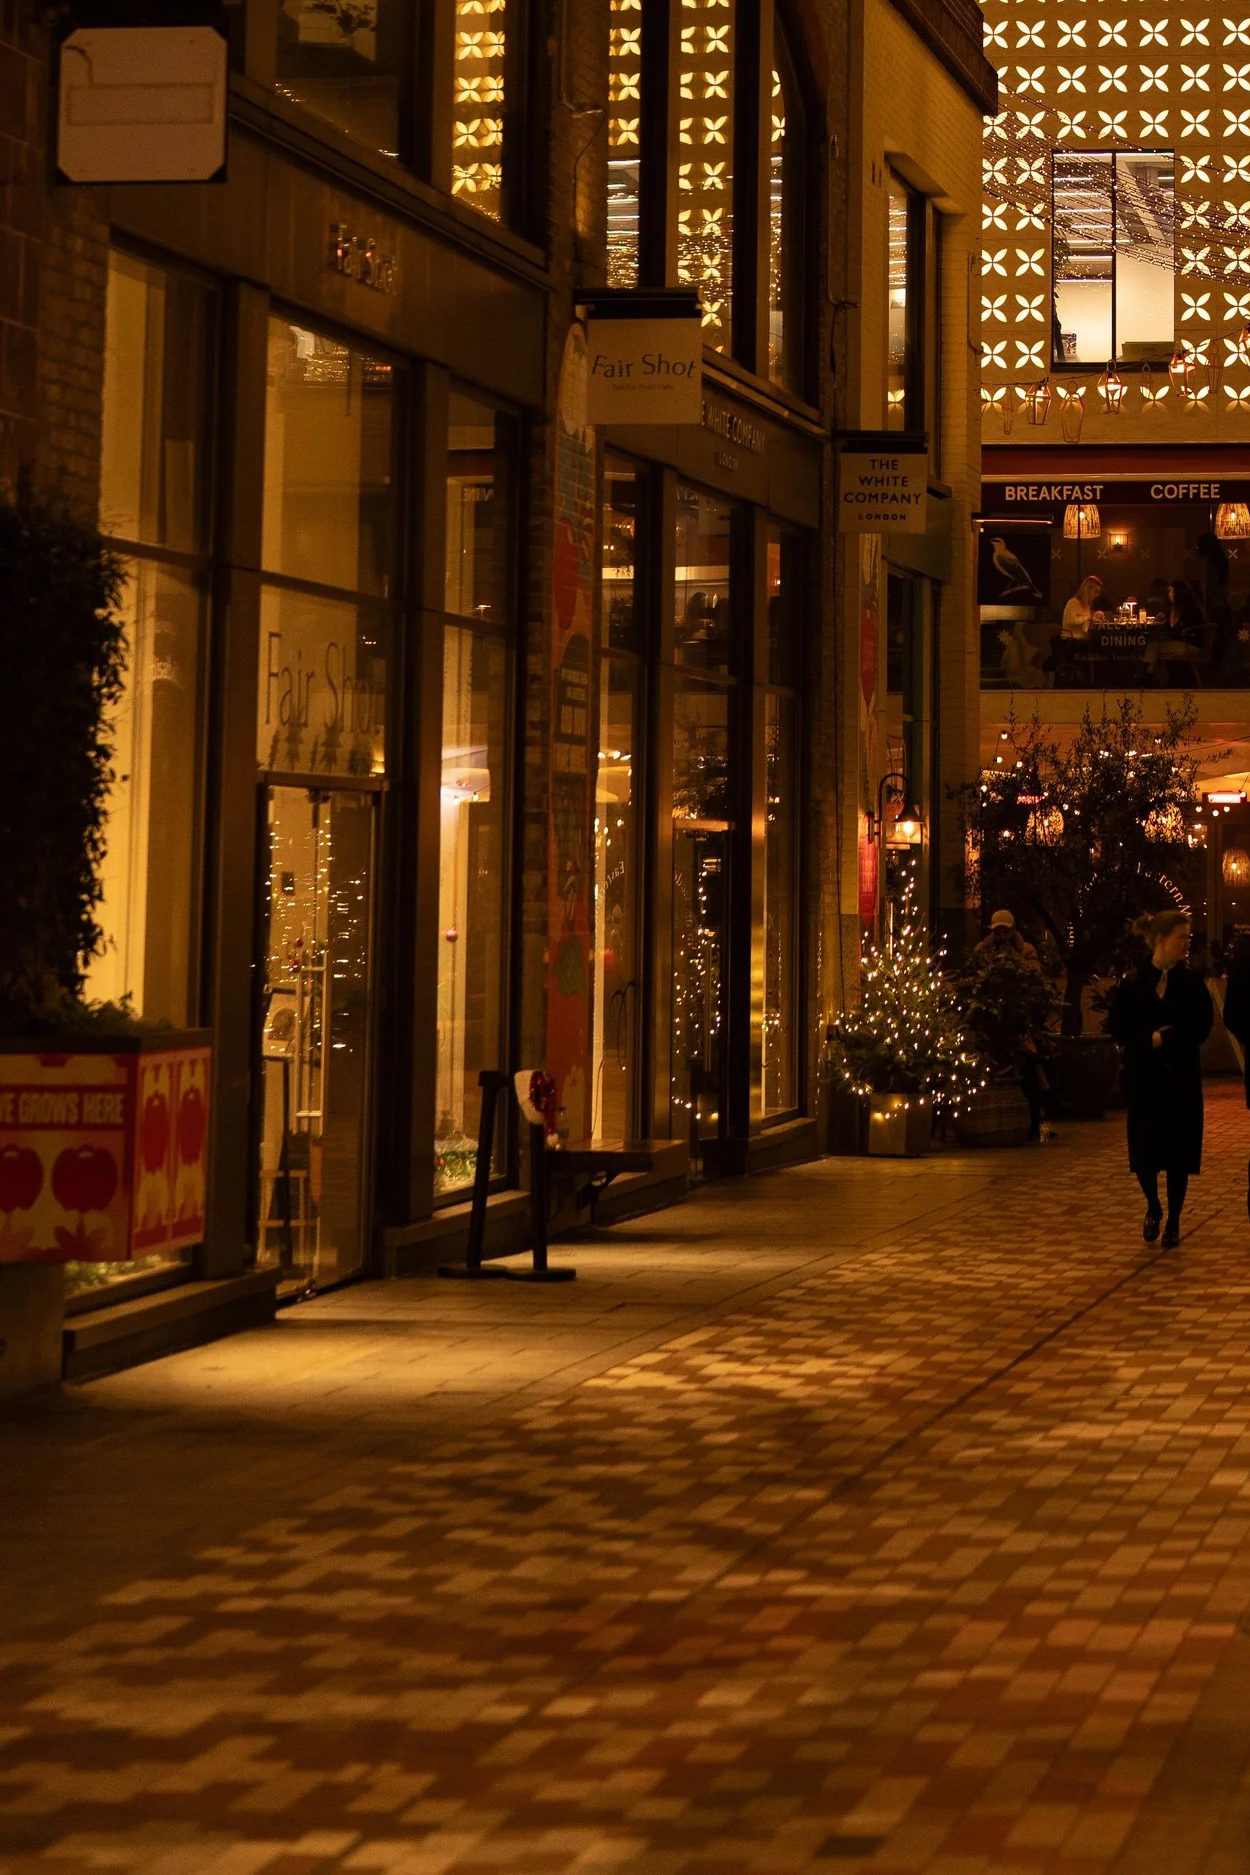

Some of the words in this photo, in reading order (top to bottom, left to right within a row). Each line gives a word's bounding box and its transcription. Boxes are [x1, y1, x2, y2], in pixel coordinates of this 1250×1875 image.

[591, 354, 634, 378] Fair
[641, 353, 697, 379] Shot
[870, 459, 899, 471] THE
[859, 476, 909, 487] WHITE
[844, 492, 922, 505] COMPANY
[1005, 485, 1104, 501] BREAKFAST
[1150, 483, 1220, 499] COFFEE
[857, 513, 906, 521] LONDON
[1101, 635, 1147, 646] DINING
[265, 631, 315, 728] Fair
[18, 1092, 79, 1124] GROWS
[82, 1092, 125, 1124] HERE
